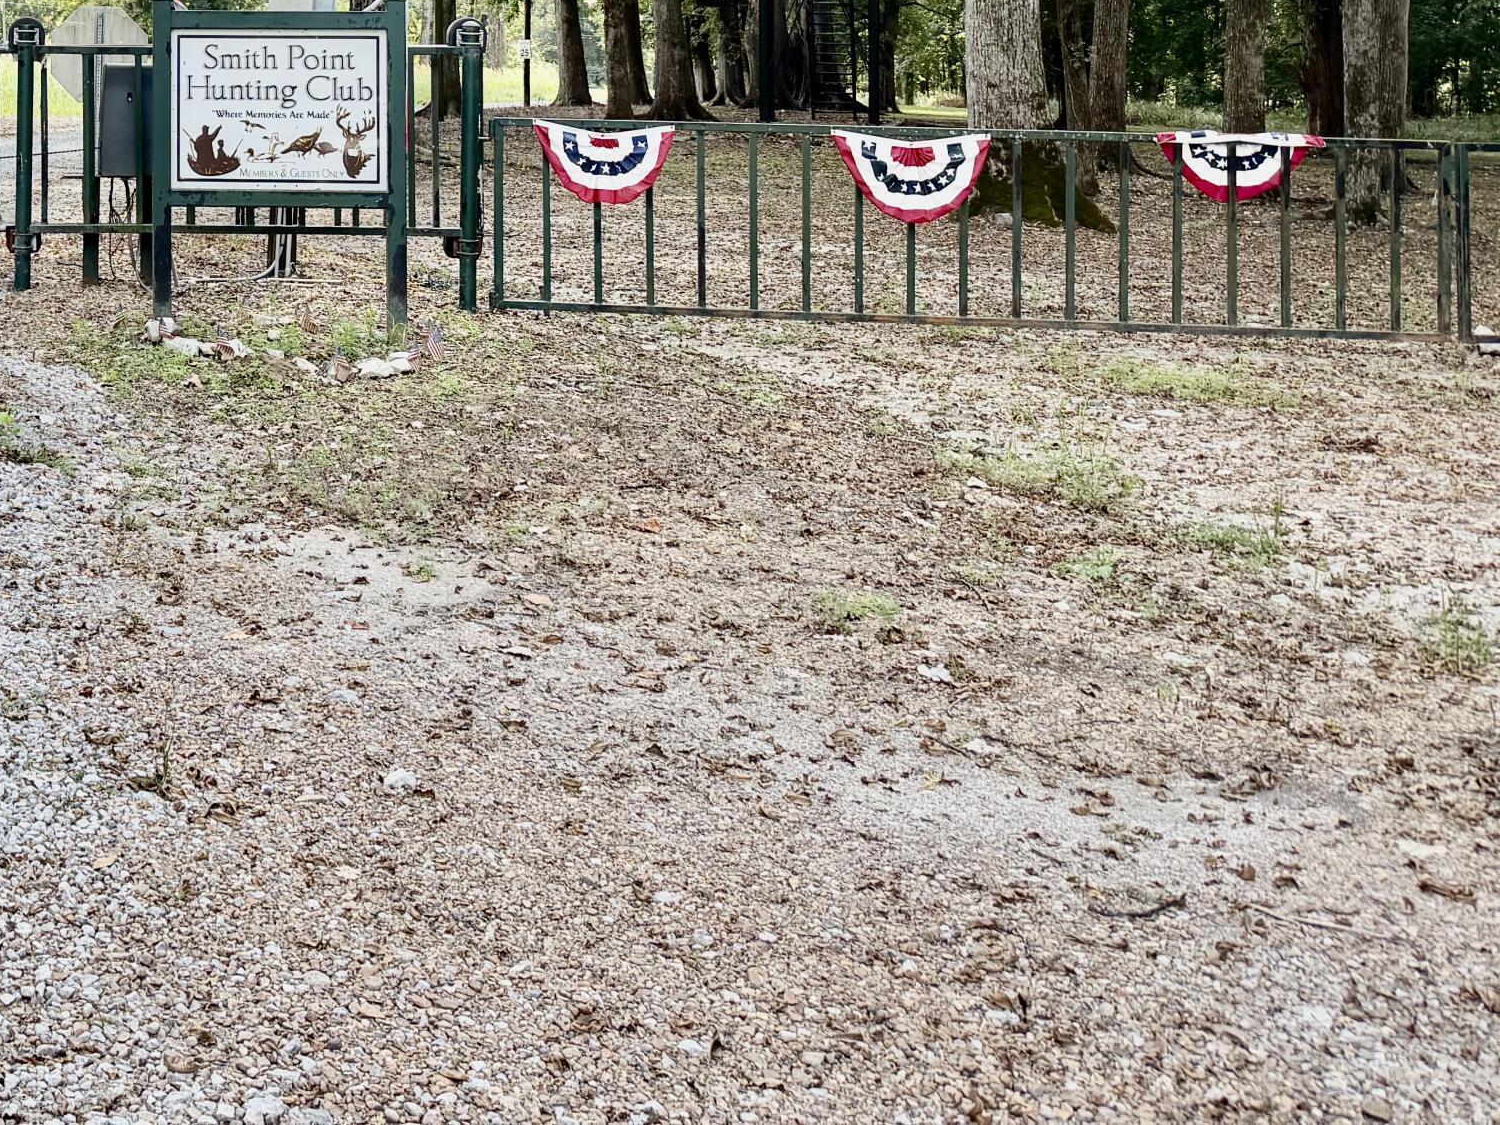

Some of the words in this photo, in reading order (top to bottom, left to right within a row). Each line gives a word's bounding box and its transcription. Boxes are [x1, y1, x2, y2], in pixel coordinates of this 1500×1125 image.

[204, 44, 278, 70] Smith
[287, 44, 356, 70] Point
[186, 75, 297, 108] Hunting
[306, 75, 373, 101] Club
[245, 110, 287, 119] Memories
[289, 110, 304, 119] Are
[239, 168, 279, 178] MEMBERS
[280, 168, 287, 178] &
[289, 168, 320, 178] GUESTS
